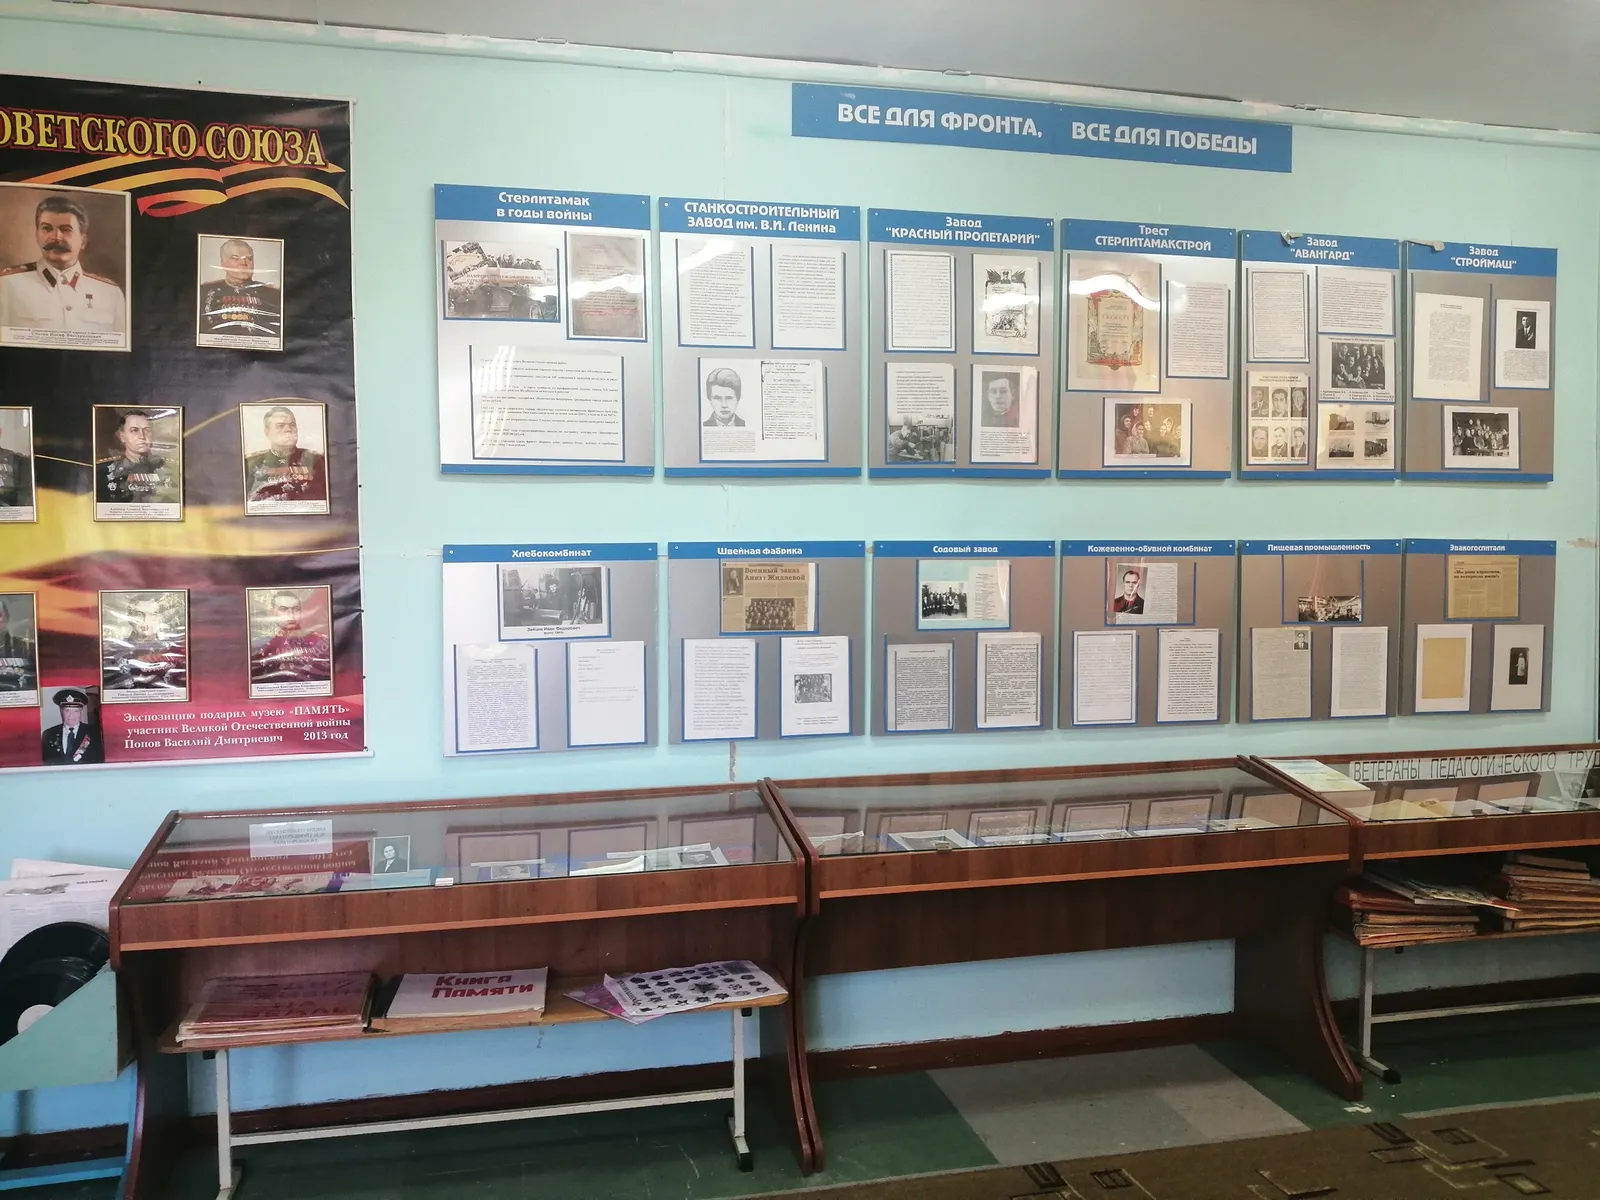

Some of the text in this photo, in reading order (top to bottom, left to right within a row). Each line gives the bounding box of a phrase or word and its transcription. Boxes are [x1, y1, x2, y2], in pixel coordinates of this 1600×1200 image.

[838, 103, 1258, 155] ВСЕ ДЛЯ ФРОНТА, ВСЕ ДЛЯ ПОБЕДЫ
[205, 124, 326, 167] СОЮЗА
[498, 191, 590, 206] Стерлитамак
[496, 208, 592, 221] в годы войны
[684, 201, 840, 220] СТАНКОСТРОИТЕЛЬНЫЙ
[687, 216, 837, 234] ЗАВОД им. В.И. Ленина
[945, 216, 982, 228] Завод
[886, 227, 1040, 244] "КРАСНЫЙ ПРОЛЕТАРИЙ"
[1139, 224, 1170, 236] Трест
[1096, 236, 1212, 251] СТЕРЛИТАМАКСТРОЙ
[1306, 236, 1338, 248] Завод
[1290, 248, 1355, 260] "АВАНГАРД"
[1468, 246, 1499, 256] Завод
[1450, 256, 1517, 270] "СТРОЙМАШ"
[512, 548, 592, 558] Хлебокомбинат
[717, 547, 760, 555] Швейная
[932, 545, 971, 554] Содовый
[1088, 544, 1212, 553] Кожевенно-обувной комбинат
[1268, 544, 1371, 552] Пищевая промышленность
[1450, 544, 1506, 552] Эвакогоспитали
[123, 705, 350, 723] Экспозицию подарил музею «ПАМЯТЬ»
[126, 718, 351, 737] участник Великой Отечественной войны
[124, 730, 348, 750] Попов Василий Дмитриевич 2013 год
[1353, 758, 1422, 782] ВЕТЕРАНЫ
[1430, 752, 1556, 780] ПЕДАГОГИЧЕСКОГО
[436, 974, 513, 986] Книга
[432, 983, 535, 999] Памяти
